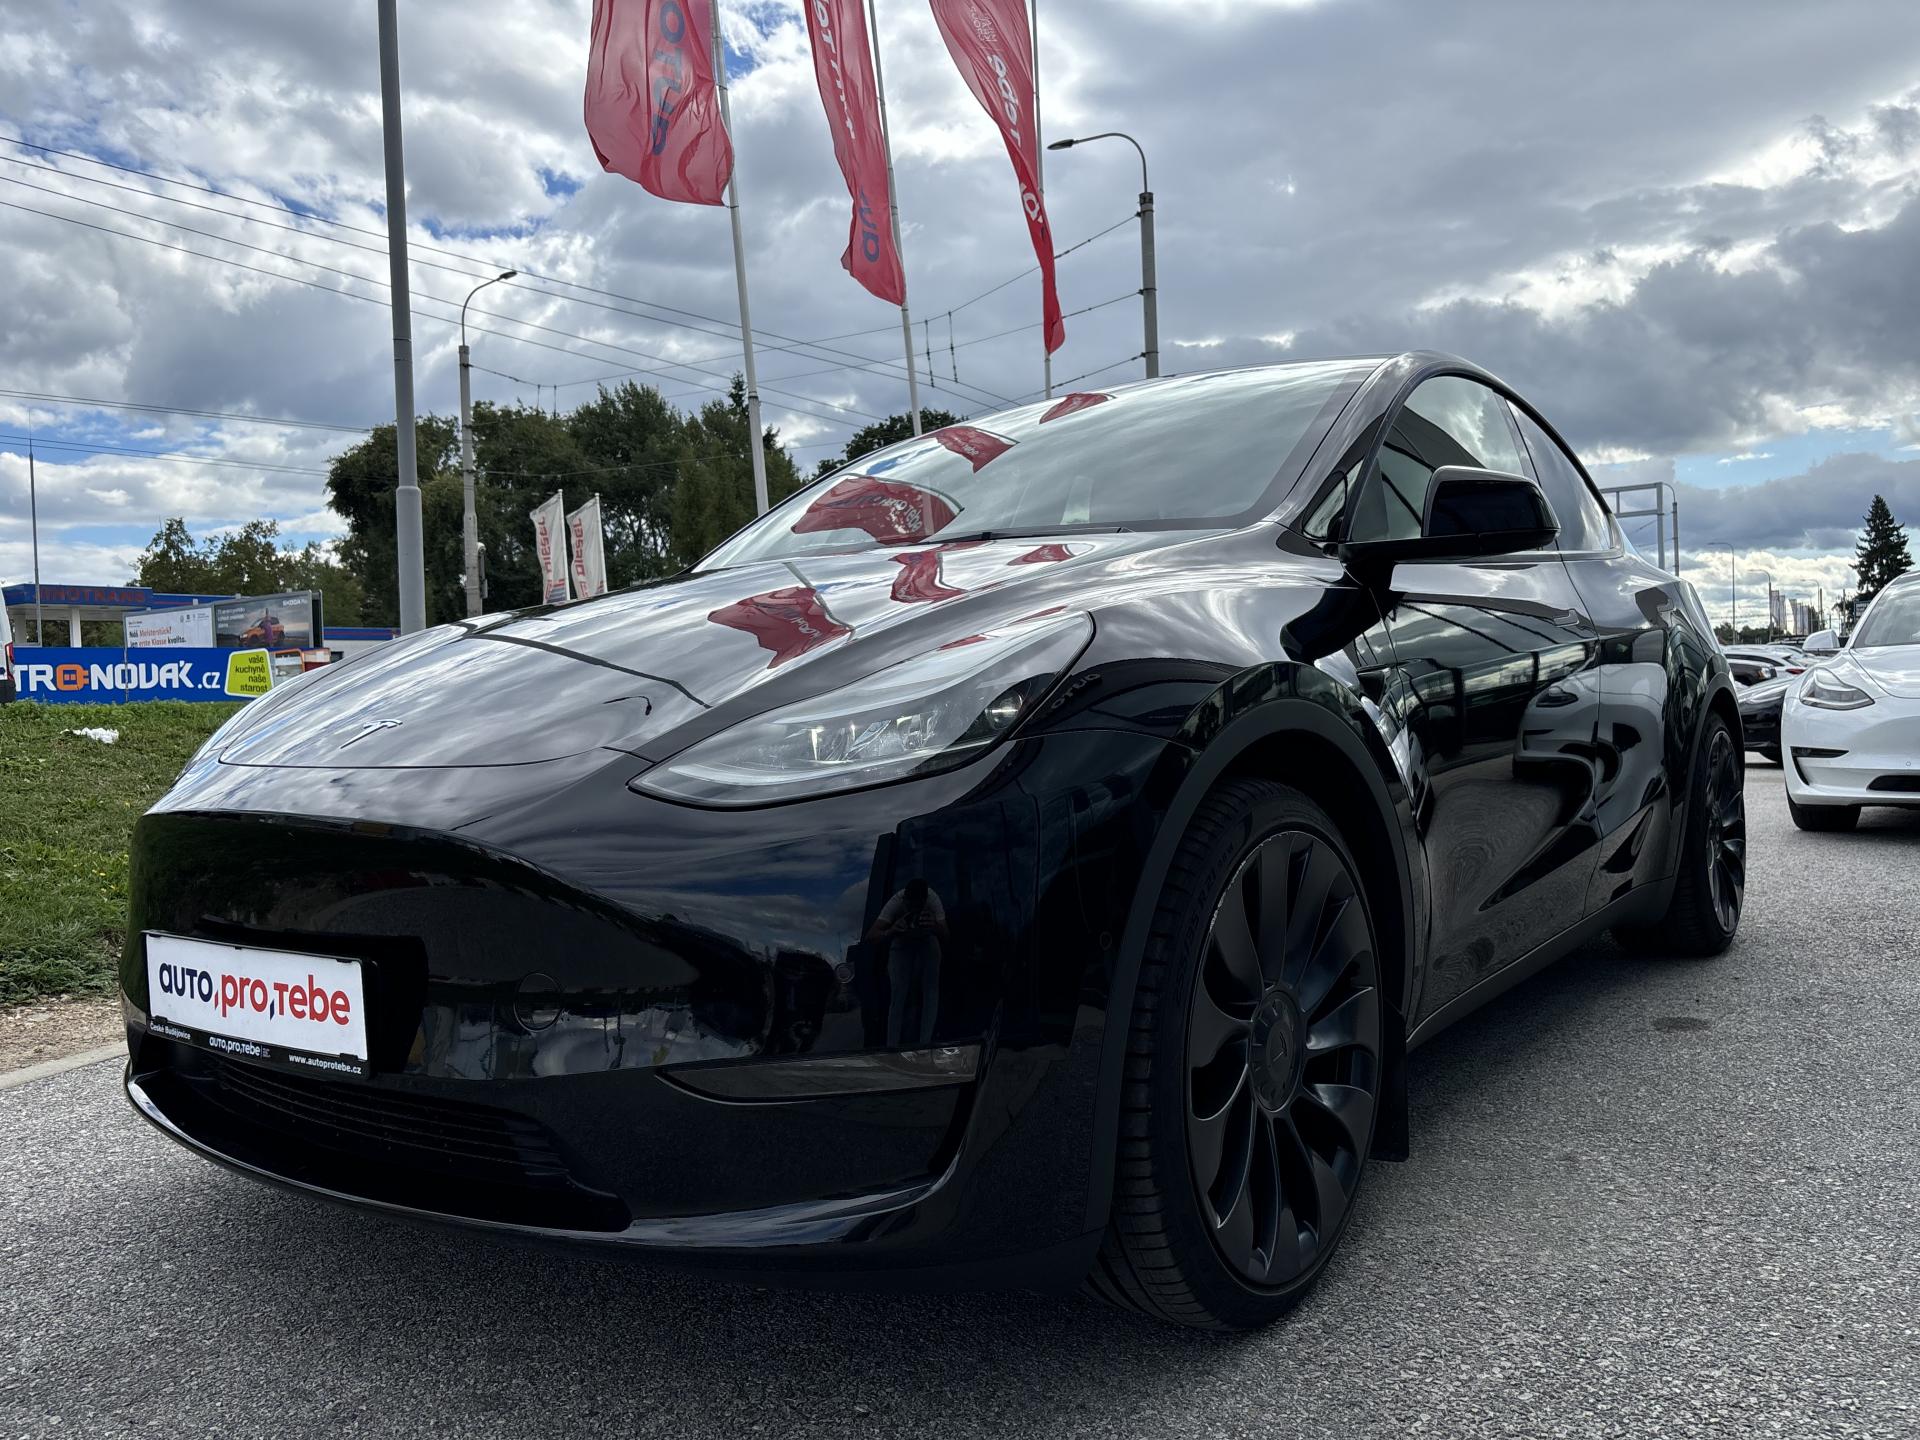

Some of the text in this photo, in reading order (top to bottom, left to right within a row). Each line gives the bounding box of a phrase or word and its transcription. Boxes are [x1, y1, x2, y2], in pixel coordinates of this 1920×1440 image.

[248, 655, 264, 664] vaše
[235, 664, 265, 674] kuchyně
[248, 675, 267, 683] naše
[240, 683, 268, 692] starost
[289, 1053, 362, 1075] www.autoprotebe.cz
